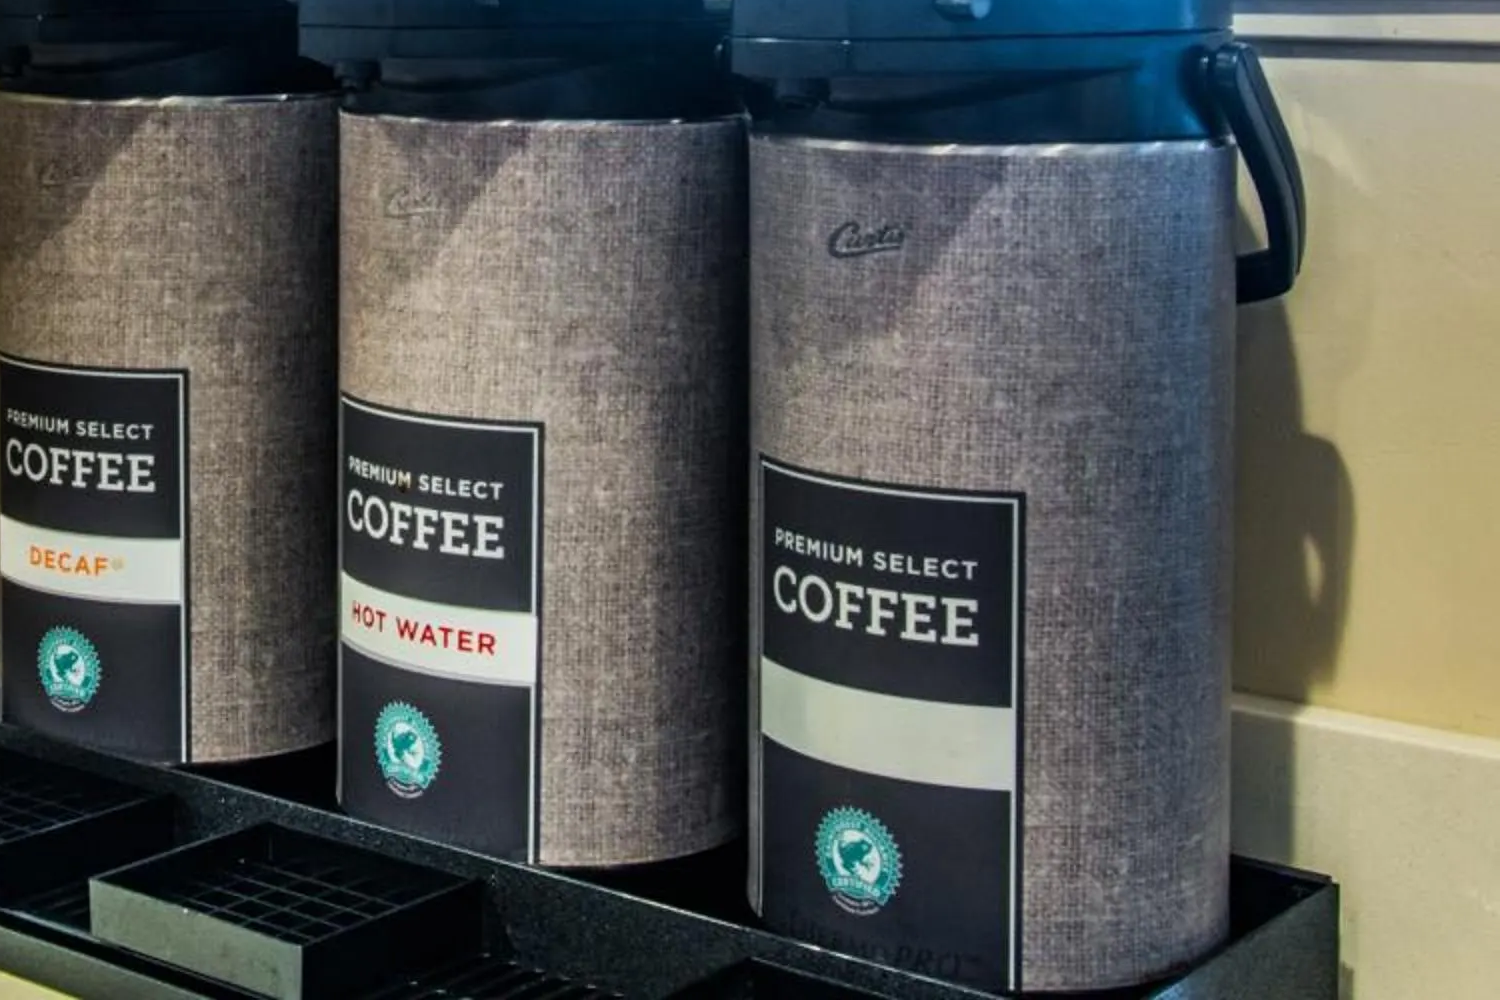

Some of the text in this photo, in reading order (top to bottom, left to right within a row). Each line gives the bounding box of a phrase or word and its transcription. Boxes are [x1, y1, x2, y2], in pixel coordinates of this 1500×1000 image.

[6, 408, 155, 441] PREMIUM SELECT
[6, 438, 156, 493] COFFEE
[348, 455, 505, 501] PREMIUM SELECT
[347, 489, 505, 560] COFFEE
[29, 544, 109, 576] DECAF
[775, 527, 979, 580] PREMIUM SELECT
[352, 600, 498, 656] HOT WATER
[773, 565, 980, 647] COFFEE
